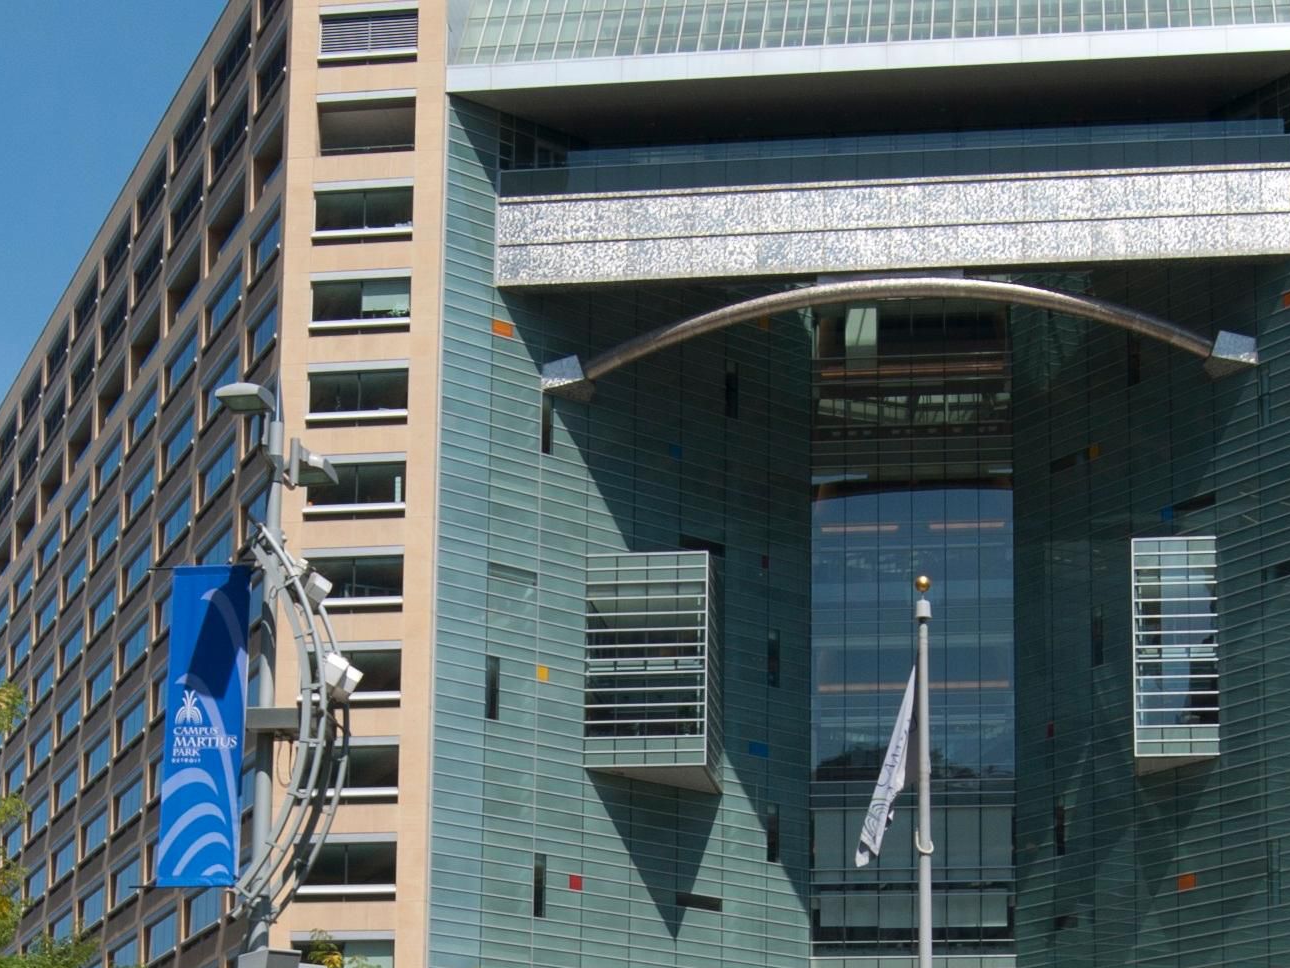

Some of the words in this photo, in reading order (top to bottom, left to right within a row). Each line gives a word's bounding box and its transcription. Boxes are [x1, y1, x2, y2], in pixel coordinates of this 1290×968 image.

[173, 726, 218, 736] CAMPUS
[173, 736, 237, 748] MARTIUS
[172, 748, 200, 757] PARK
